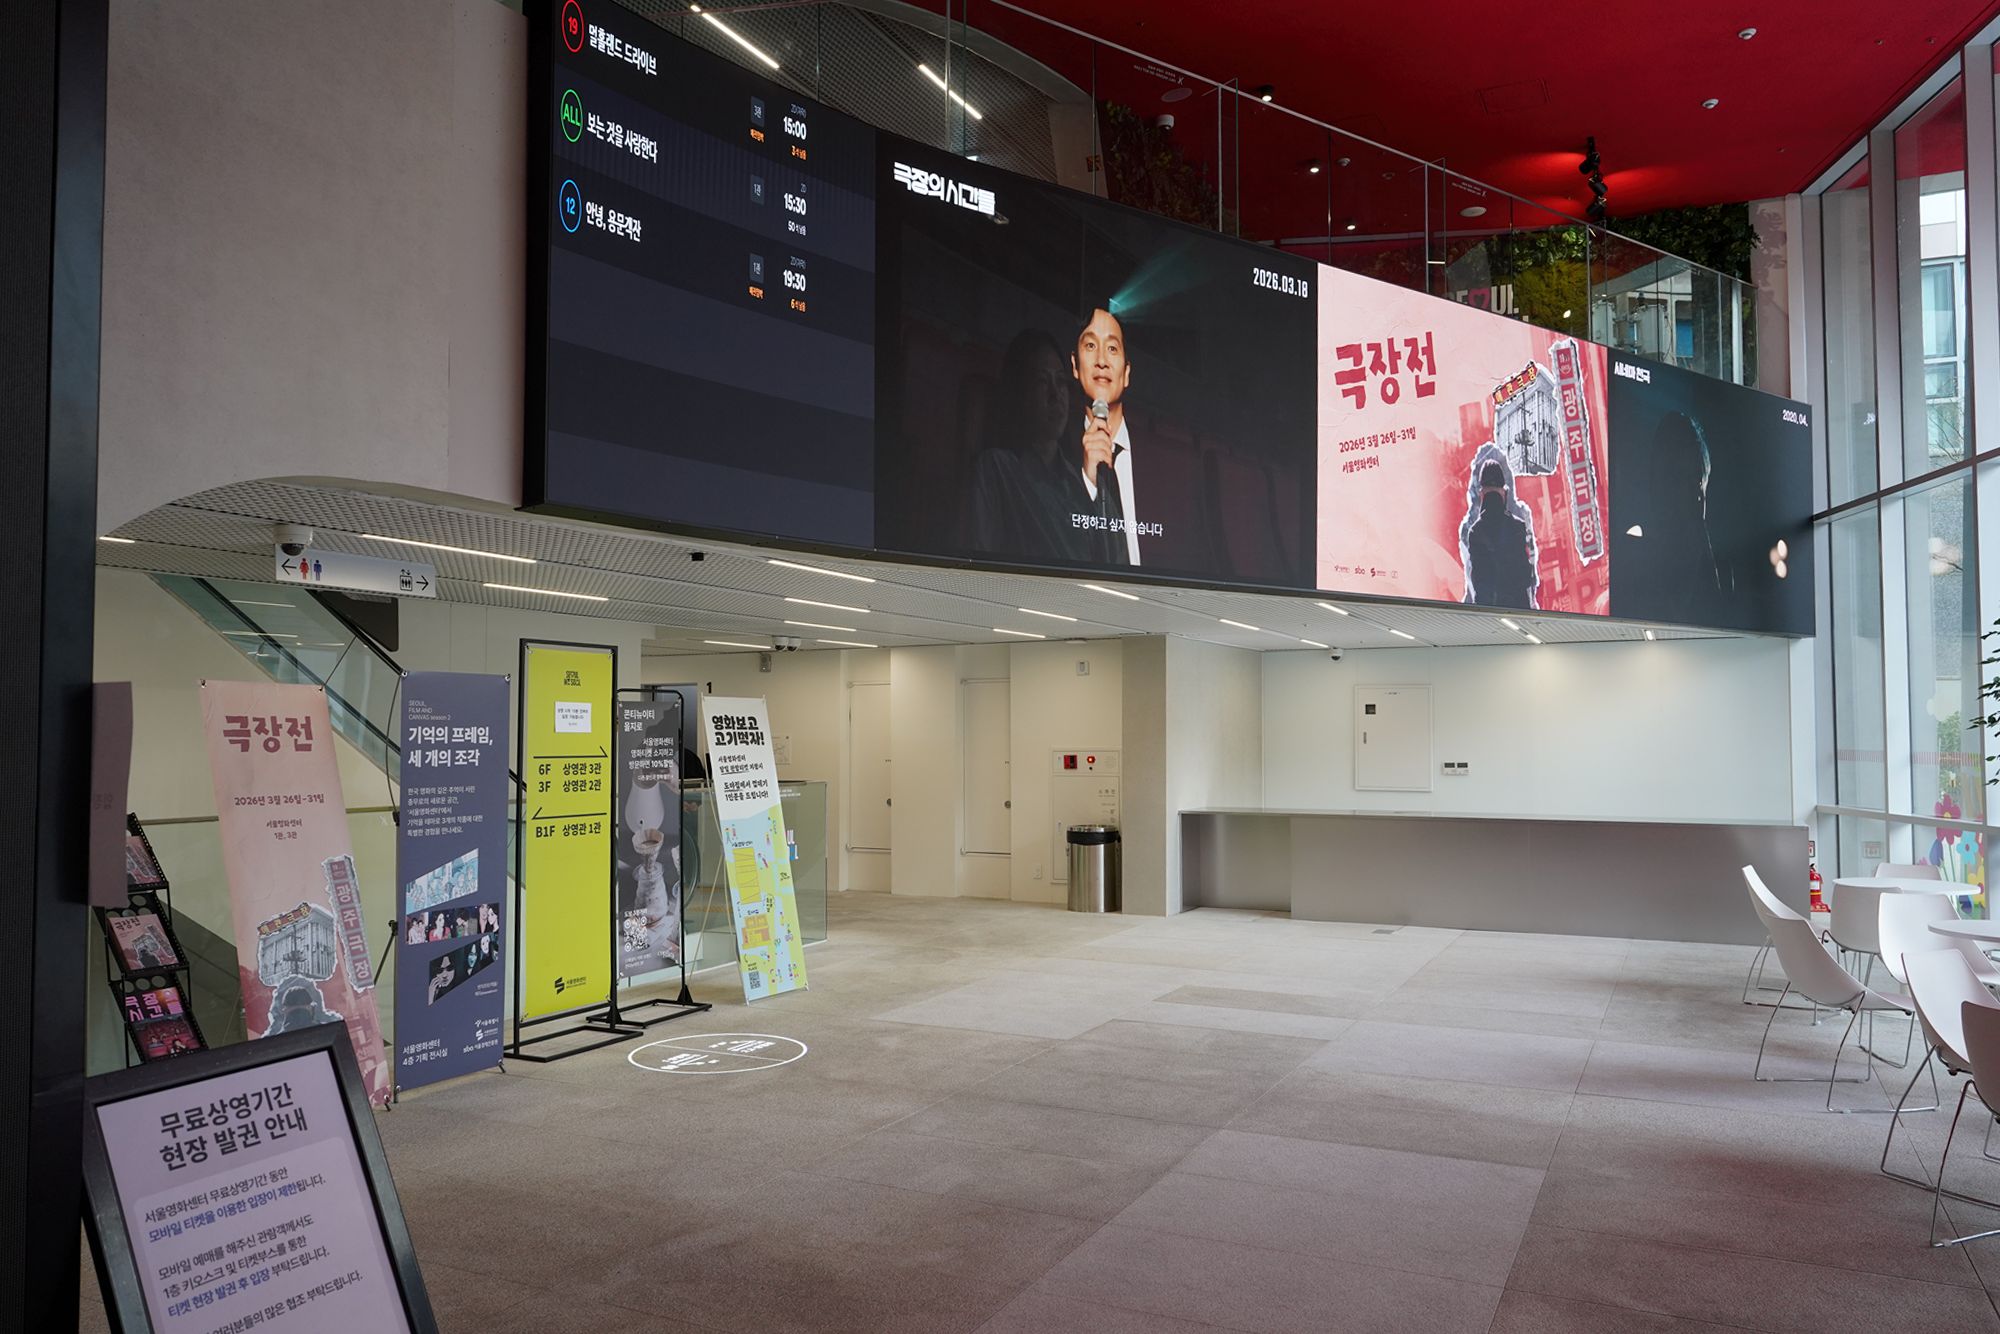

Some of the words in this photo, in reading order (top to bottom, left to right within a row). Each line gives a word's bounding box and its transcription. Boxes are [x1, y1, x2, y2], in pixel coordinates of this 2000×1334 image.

[568, 16, 578, 35] 19
[588, 24, 623, 58] 멀홀랜드
[624, 43, 657, 75] 드라이브
[563, 103, 581, 126] ALL
[587, 112, 605, 140] 보는
[606, 121, 624, 148] 것을
[624, 130, 658, 163] 사랑한다
[783, 116, 807, 140] 15:00
[893, 161, 945, 201] 극장의
[566, 197, 576, 215] 12
[784, 193, 806, 215] 15:30
[586, 201, 606, 230] 안녕,
[607, 210, 641, 242] 용문객잔
[783, 269, 806, 291] 19:30
[1253, 267, 1308, 298] 2026.03.18
[1334, 331, 1436, 410] 극장전
[1339, 437, 1366, 453] 2026년
[1367, 434, 1379, 449] 3월
[1342, 455, 1380, 474] 서울영화센터
[1563, 387, 1595, 543] 광주극장
[1071, 513, 1108, 530] 단정하고
[1109, 517, 1127, 533] 싶지
[1128, 520, 1163, 537] 않습니다
[706, 681, 713, 694] 1
[624, 721, 643, 732] 을지로
[711, 714, 759, 731] 영화보고
[222, 715, 314, 753] 극장전
[408, 726, 449, 745] 기억의
[452, 726, 493, 746] 프레임,
[643, 737, 674, 746] 서울영화센터
[714, 731, 765, 746] 고기먹자!
[408, 749, 422, 768] 세
[424, 749, 451, 768] 개의
[454, 749, 480, 767] 조각
[538, 764, 552, 776] 6F
[563, 763, 587, 776] 상영관
[589, 762, 602, 775] 3관
[538, 780, 552, 793] 3F
[563, 779, 587, 792] 상영관
[589, 779, 602, 791] 2관
[234, 796, 266, 806] 2026년
[267, 795, 281, 806] 3월
[266, 818, 302, 828] 서울영화센터
[536, 825, 556, 838] B1F
[563, 823, 587, 837] 상영관
[589, 821, 602, 834] 1관
[287, 831, 298, 840] 3관
[336, 883, 371, 980] 광주극장
[402, 1038, 440, 1055] 서울영화센터
[402, 1055, 415, 1067] 4층
[429, 1047, 448, 1061] 전시실
[160, 1082, 294, 1139] 무료상영기간
[159, 1136, 208, 1171] 현장
[213, 1121, 262, 1156] 발권
[264, 1107, 308, 1140] 안내
[144, 1193, 209, 1223] 서울영화센터
[209, 1174, 268, 1202] 무료상영기간
[269, 1166, 289, 1184] 동안
[148, 1221, 183, 1243] 모바일
[183, 1209, 217, 1231] 티켓을
[216, 1199, 248, 1219] 이용한
[247, 1188, 278, 1209] 입장이
[278, 1173, 327, 1199] 제한됩니다.
[158, 1259, 191, 1280] 모바일
[192, 1246, 225, 1268] 예매를
[225, 1234, 257, 1255] 해주신
[256, 1213, 315, 1244] 관람객께서도
[162, 1282, 182, 1300] 1층
[182, 1265, 226, 1292] 키오스크
[225, 1262, 237, 1277] 및
[238, 1241, 287, 1270] 티켓부스를
[286, 1234, 308, 1251] 통한
[167, 1300, 193, 1319] 티켓
[192, 1290, 215, 1310] 현장
[214, 1282, 237, 1301] 발권
[238, 1277, 250, 1291] 후
[249, 1266, 271, 1286] 입장
[270, 1246, 331, 1277] 부탁드립니다.
[213, 1310, 265, 1334] 여러분들의
[264, 1301, 287, 1320] 많은
[286, 1293, 308, 1312] 협조
[306, 1269, 364, 1302] 부탁드립니다.
